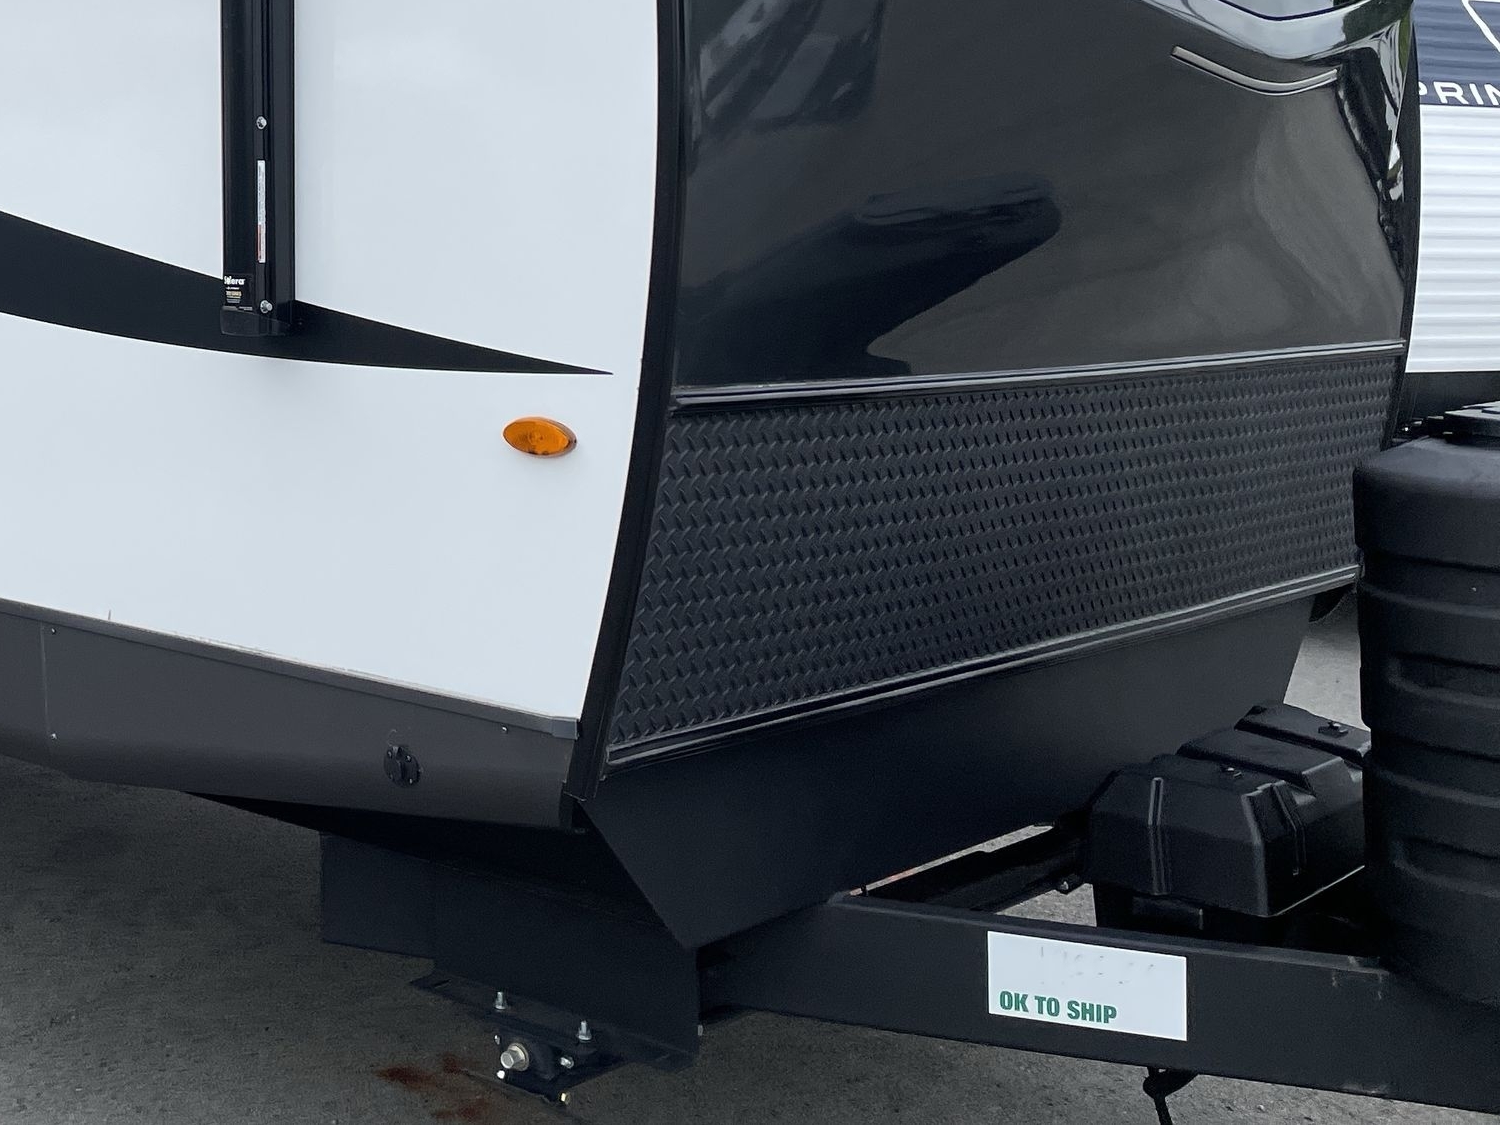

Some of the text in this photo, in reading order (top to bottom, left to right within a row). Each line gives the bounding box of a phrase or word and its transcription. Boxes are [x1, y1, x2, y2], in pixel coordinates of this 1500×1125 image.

[1000, 991, 1117, 1024] OK TO SHIP
